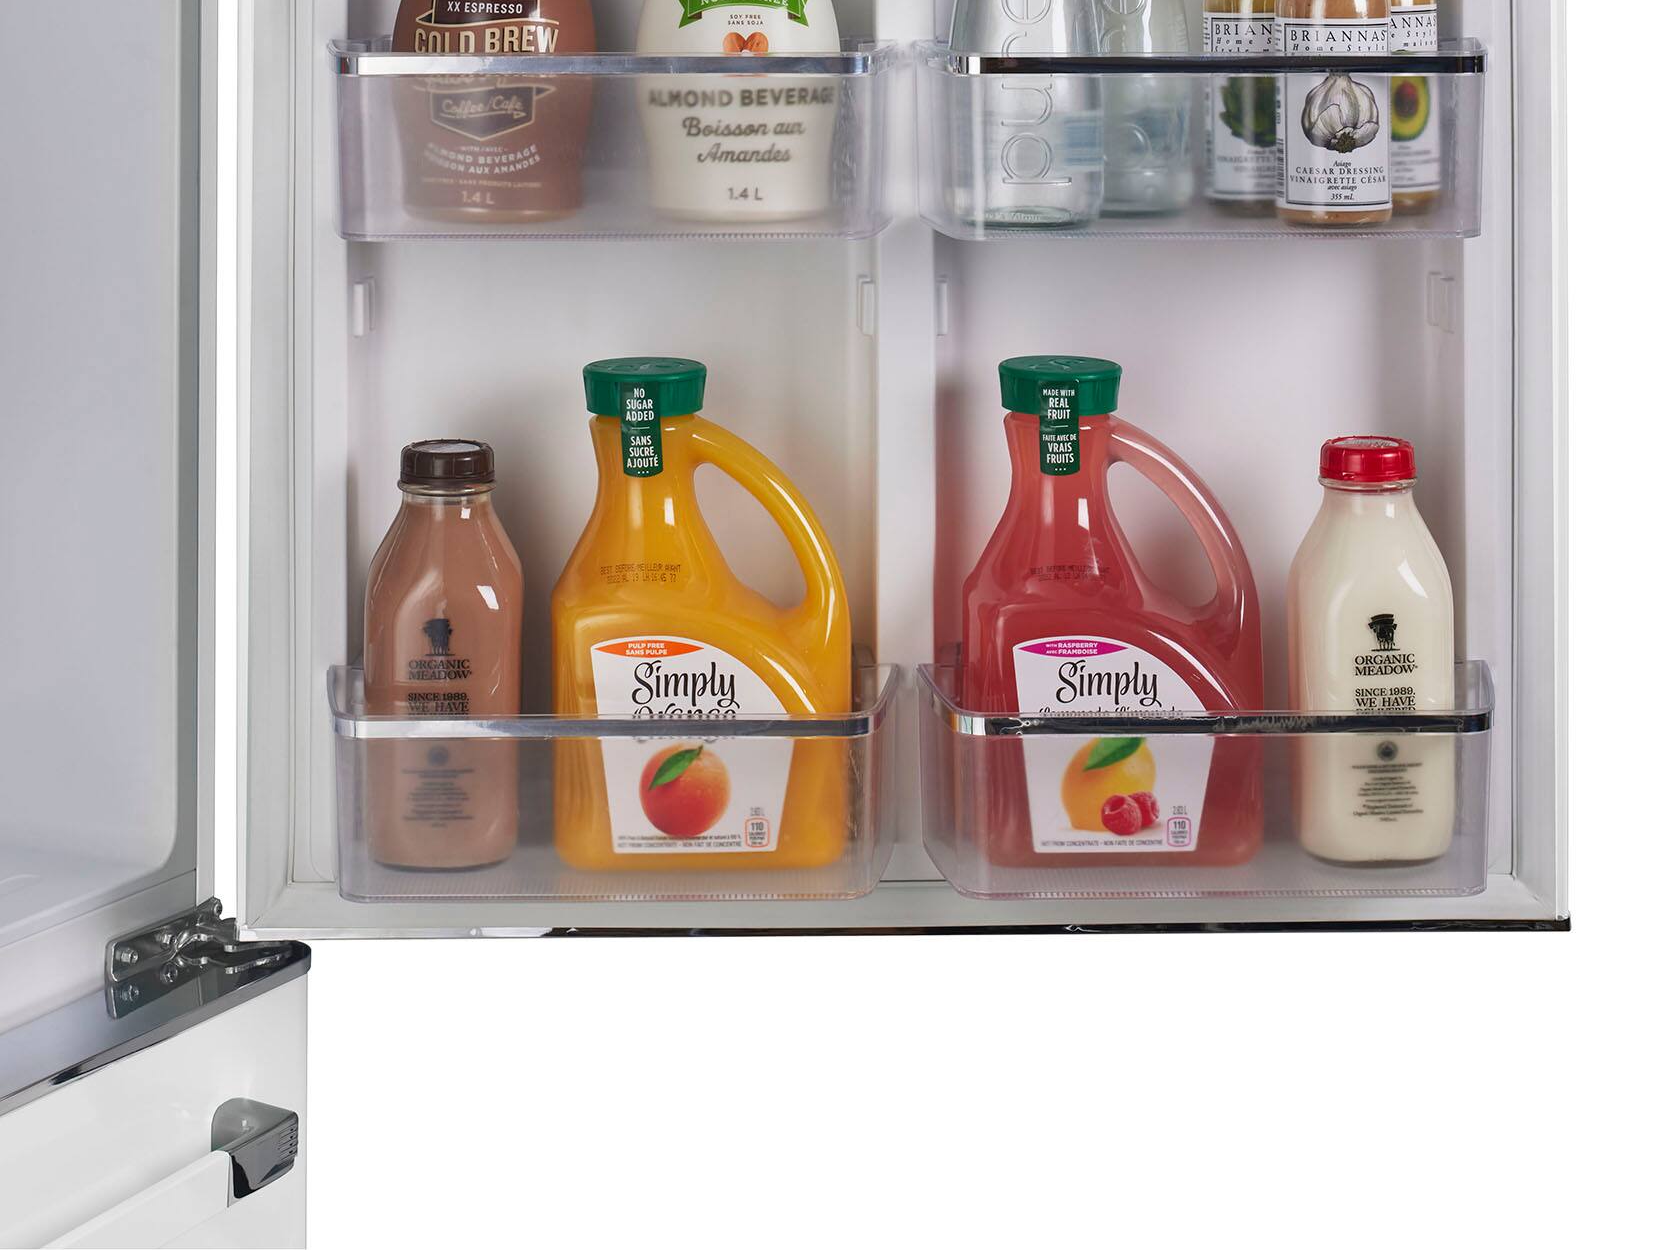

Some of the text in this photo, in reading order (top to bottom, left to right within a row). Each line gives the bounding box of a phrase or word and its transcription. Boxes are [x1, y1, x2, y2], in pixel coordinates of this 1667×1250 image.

[447, 1, 523, 14] XX ESPRESSO
[1390, 16, 1437, 30] ANNAS
[1215, 23, 1273, 35] BRIAN
[484, 25, 560, 54] BREW
[1216, 37, 1253, 45] Home
[1290, 29, 1386, 42] BRIANNAS
[1347, 43, 1385, 52] Style
[648, 86, 835, 108] ALMOND BEVERAGE
[682, 116, 806, 138] Boisson aux
[427, 142, 538, 164] MOND BEVERAGE
[697, 143, 791, 163] Amandes
[468, 165, 490, 174] AUX
[493, 153, 541, 174] AMANDES
[1333, 160, 1352, 168] Asiago
[1296, 166, 1384, 175] CAESAR DRESSING
[1290, 174, 1387, 184] VINAIGRETTE CÉSAR
[461, 190, 495, 205] 1.4 L
[728, 187, 763, 200] 1.4 L
[633, 388, 645, 398] NO
[626, 399, 653, 410] SUGAR
[1048, 397, 1069, 408] REAL
[625, 411, 655, 421] ADDED
[1047, 409, 1070, 420] FRUIT
[630, 435, 652, 446] SANS
[629, 446, 654, 457] SUCRE
[1047, 442, 1072, 452] VRAIS
[626, 454, 659, 468] AJOUTÉ
[1046, 453, 1075, 464] FRUITS
[408, 659, 470, 670] ORGANIC
[1354, 653, 1415, 665] ORGANIC
[408, 670, 471, 680] MEADOW
[1355, 664, 1416, 676] MEADOW
[631, 659, 740, 709] Simply
[1055, 659, 1162, 708] Simply
[408, 692, 470, 702] SINCE 1989.
[1355, 686, 1416, 697] SINCE 1989.
[408, 701, 470, 712] WE HAVE
[1355, 696, 1416, 707] WE HAVE
[751, 821, 764, 831] 110
[1173, 820, 1186, 830] 110
